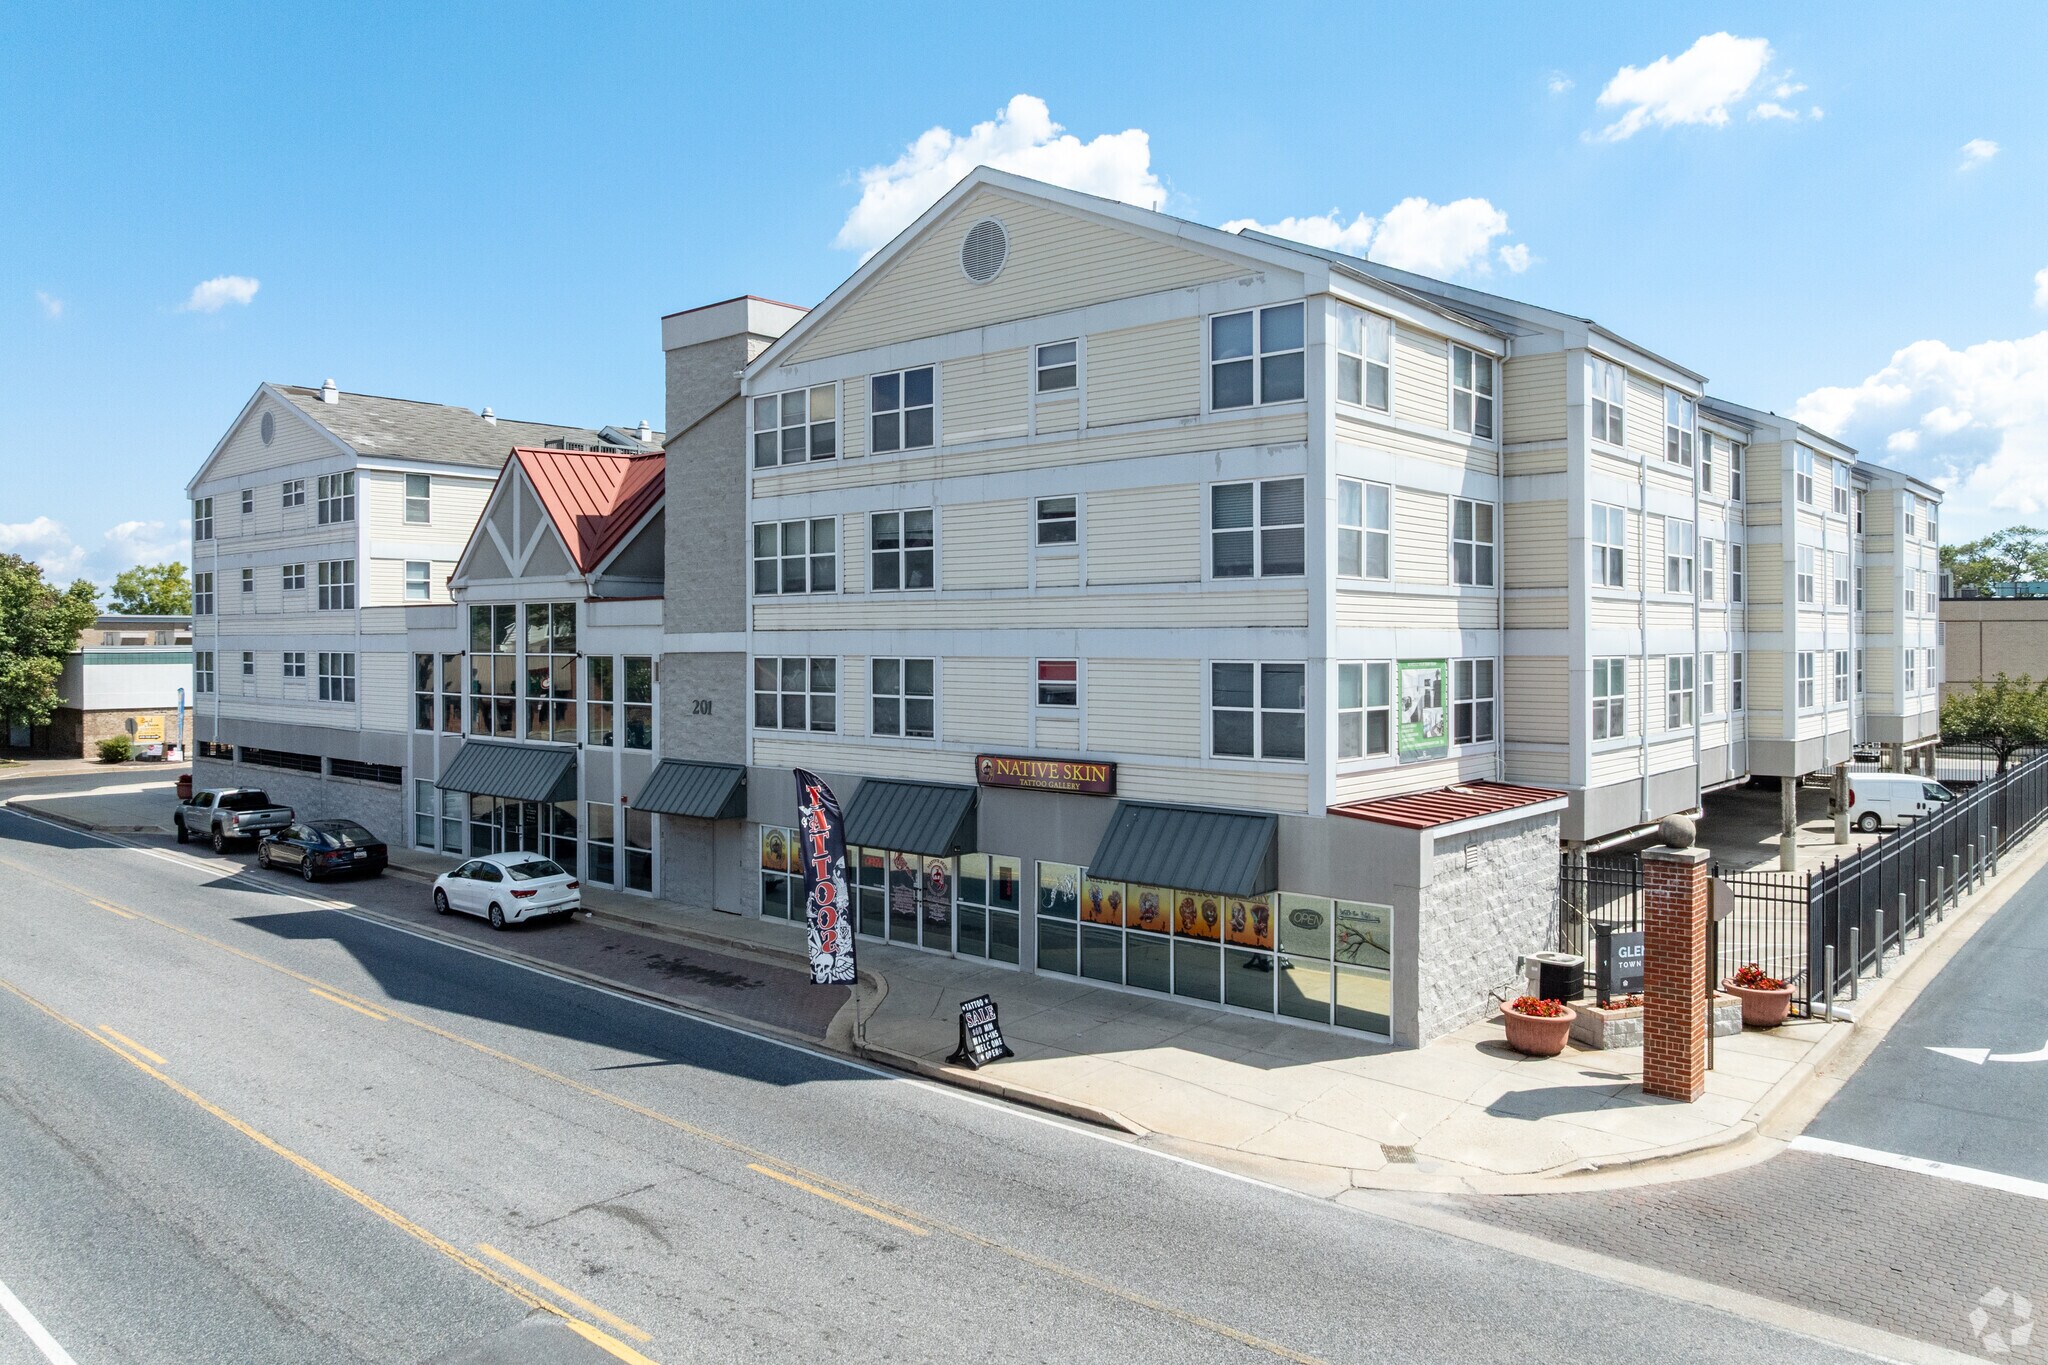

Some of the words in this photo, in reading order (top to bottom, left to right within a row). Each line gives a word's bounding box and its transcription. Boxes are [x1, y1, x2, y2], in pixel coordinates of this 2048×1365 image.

[692, 700, 712, 715] 201
[996, 760, 1059, 778] NATIVE
[1064, 764, 1106, 782] SKIN
[1020, 778, 1046, 788] TATTOO
[1048, 780, 1080, 790] GALLERY
[1294, 912, 1322, 926] OPEN
[965, 999, 984, 1010] TATTOO
[966, 1005, 996, 1028] SALE
[972, 1030, 999, 1045] WALK-INS
[985, 1048, 1000, 1059] OPEN
